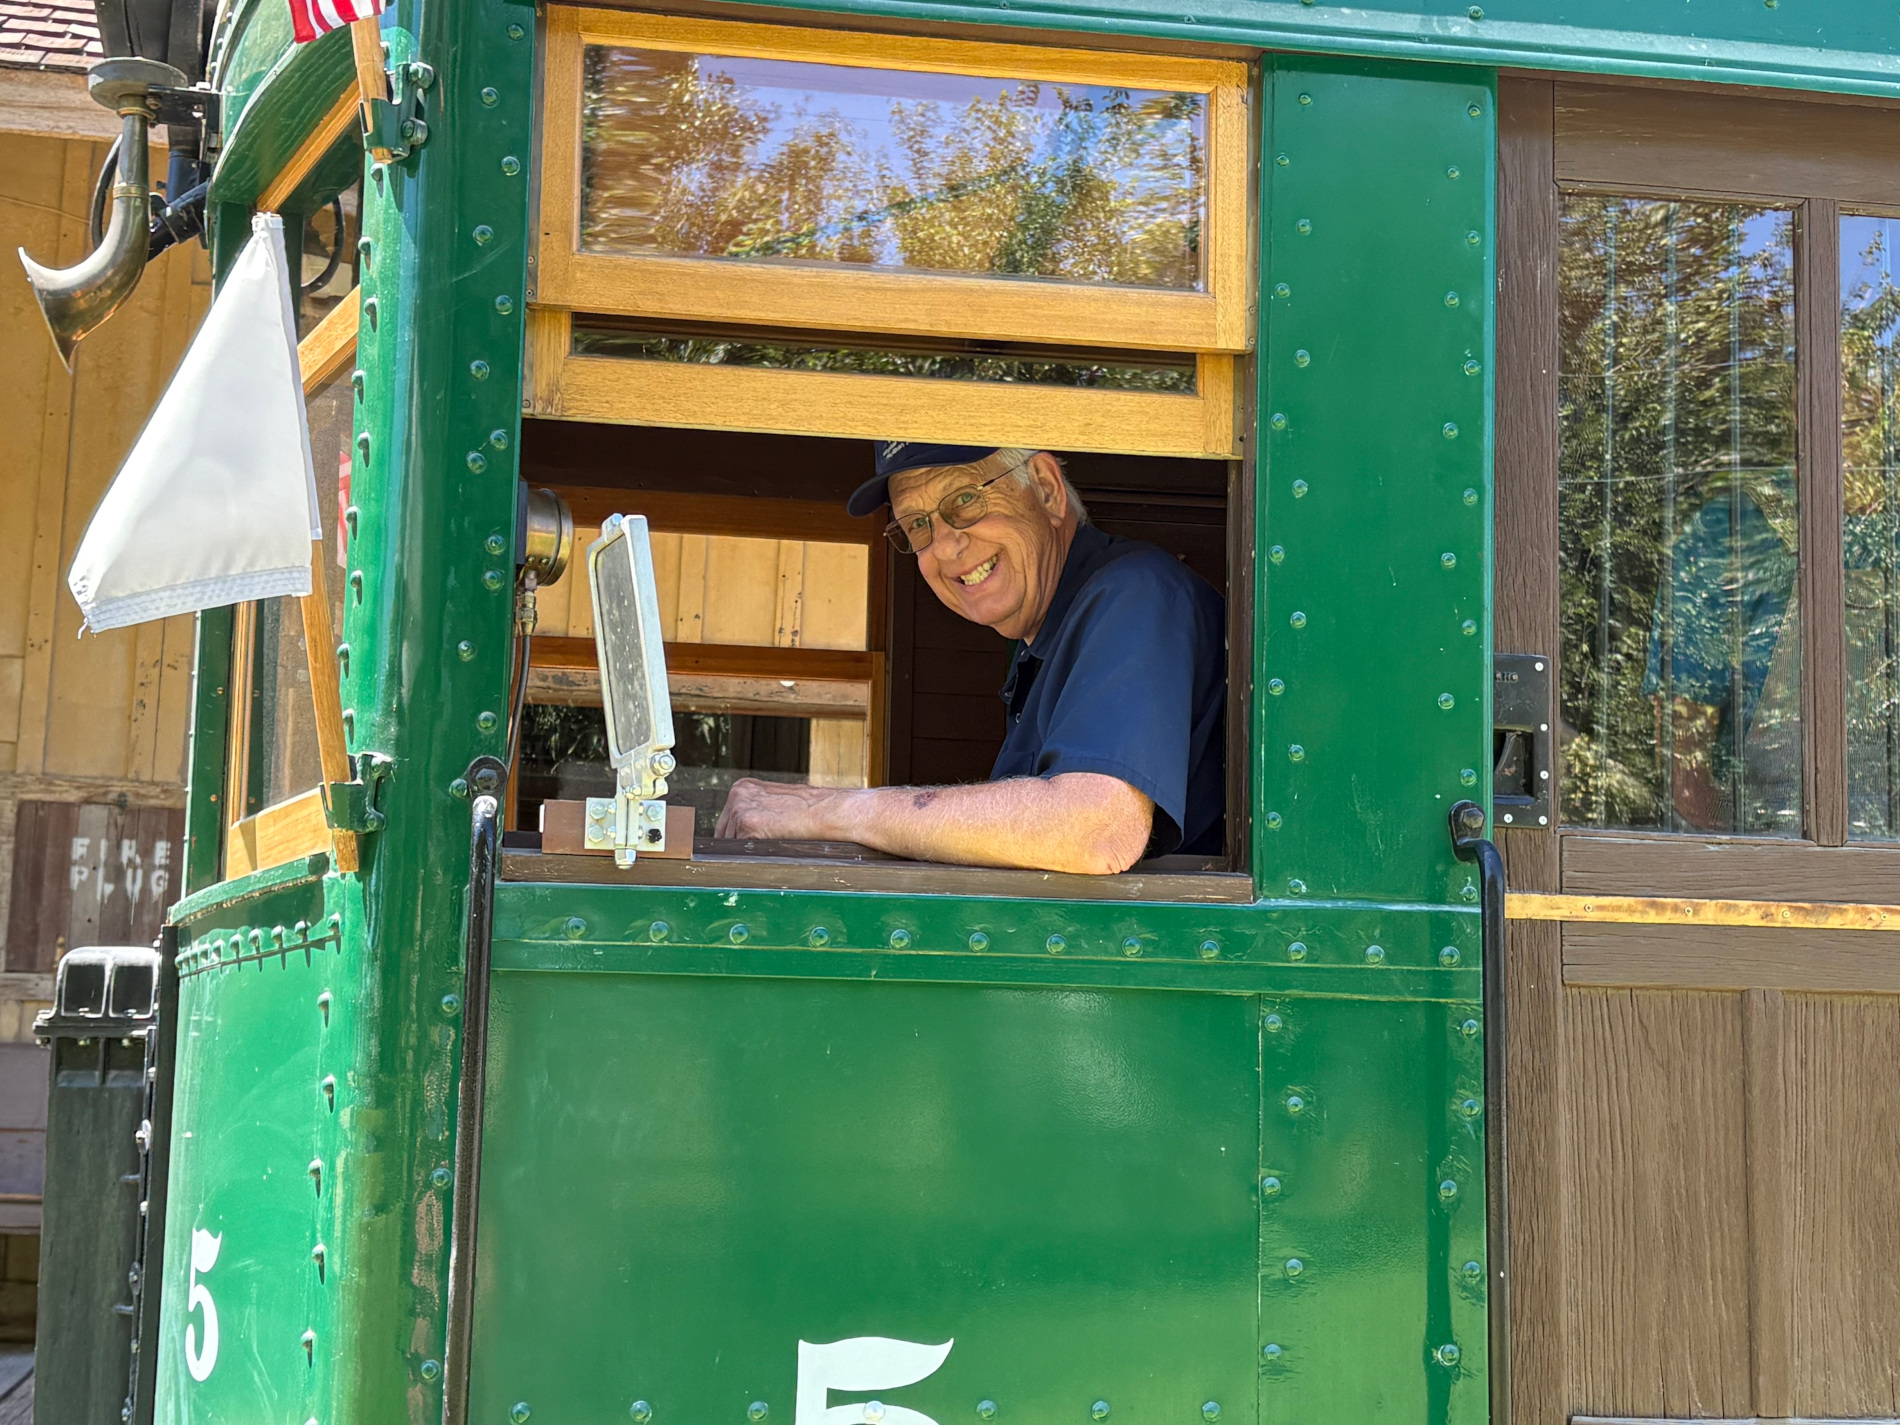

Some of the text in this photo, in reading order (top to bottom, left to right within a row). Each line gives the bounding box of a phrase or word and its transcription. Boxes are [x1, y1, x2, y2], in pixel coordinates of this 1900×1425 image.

[71, 837, 171, 870] FIRE
[70, 865, 170, 905] PLUG
[185, 1227, 222, 1382] 5
